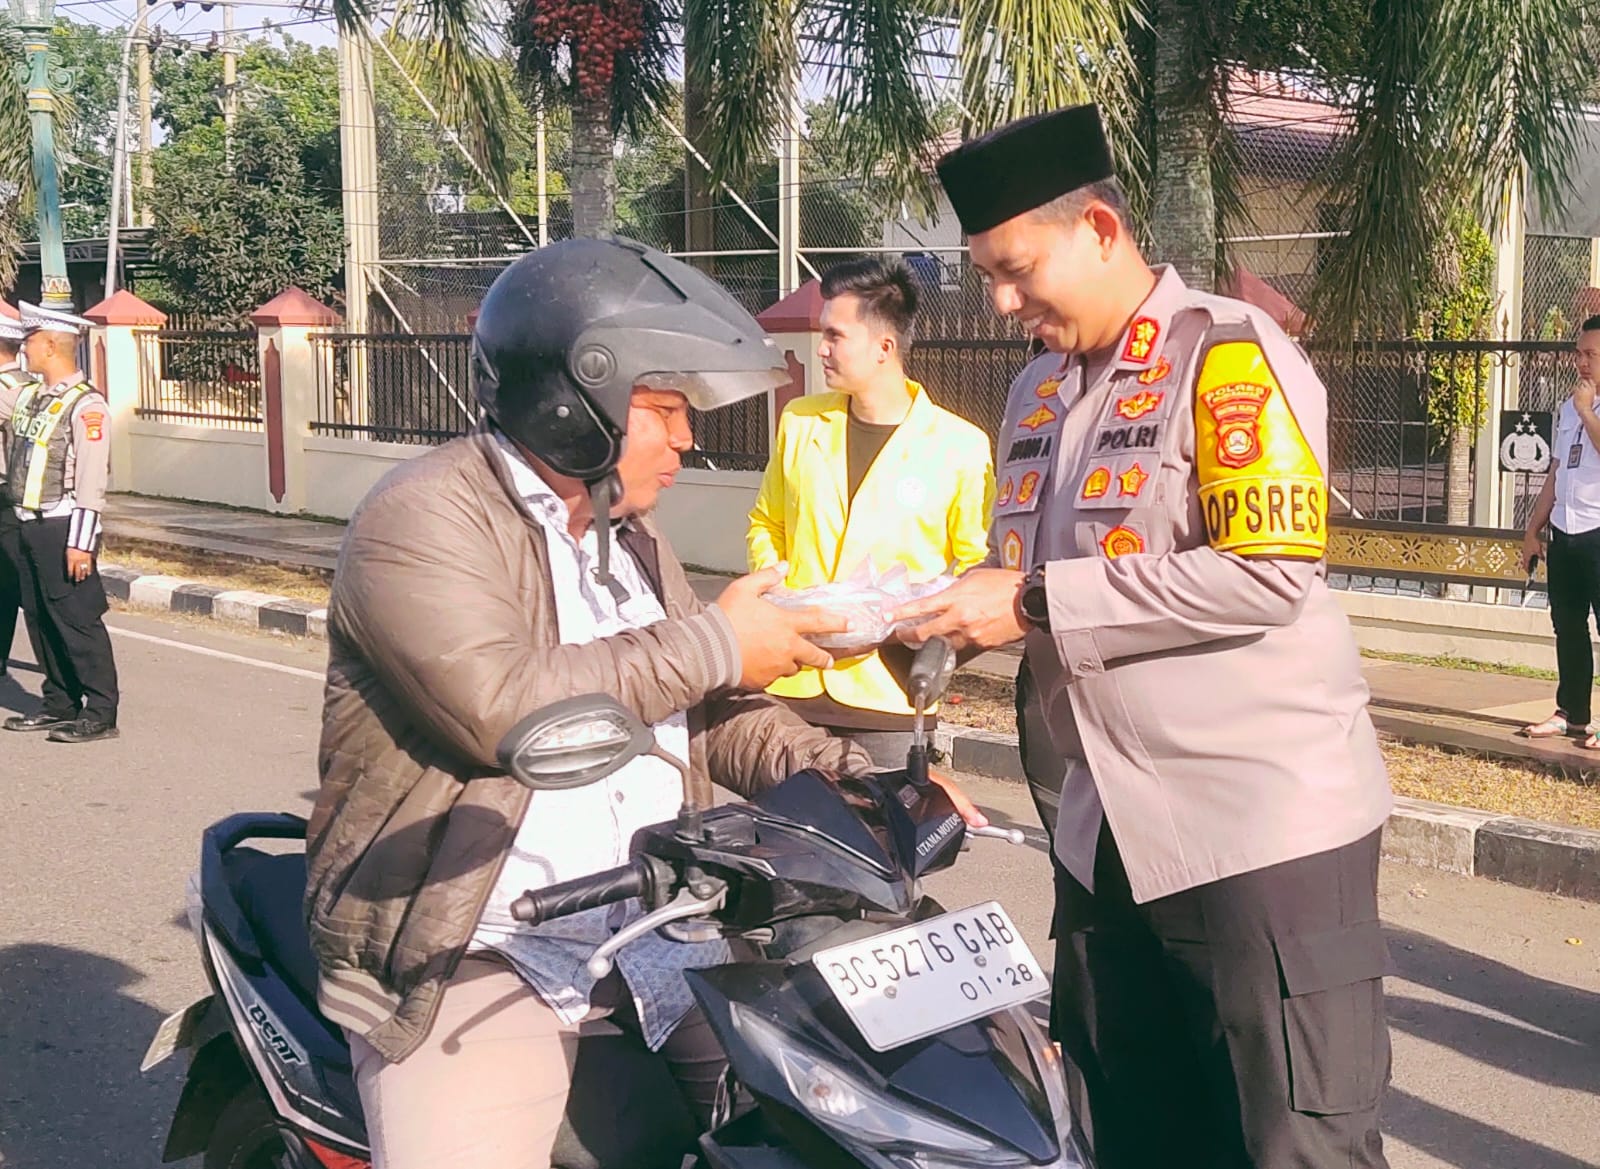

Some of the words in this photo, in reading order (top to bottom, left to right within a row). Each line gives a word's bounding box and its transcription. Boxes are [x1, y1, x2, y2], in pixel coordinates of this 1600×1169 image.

[1205, 384, 1265, 401] POLRES
[1098, 424, 1158, 450] POLRI
[1207, 484, 1320, 542] OPSRES
[916, 832, 942, 857] UTAMA
[936, 812, 962, 838] MOTOR
[871, 931, 955, 982] 5276
[953, 912, 1014, 954] GAB
